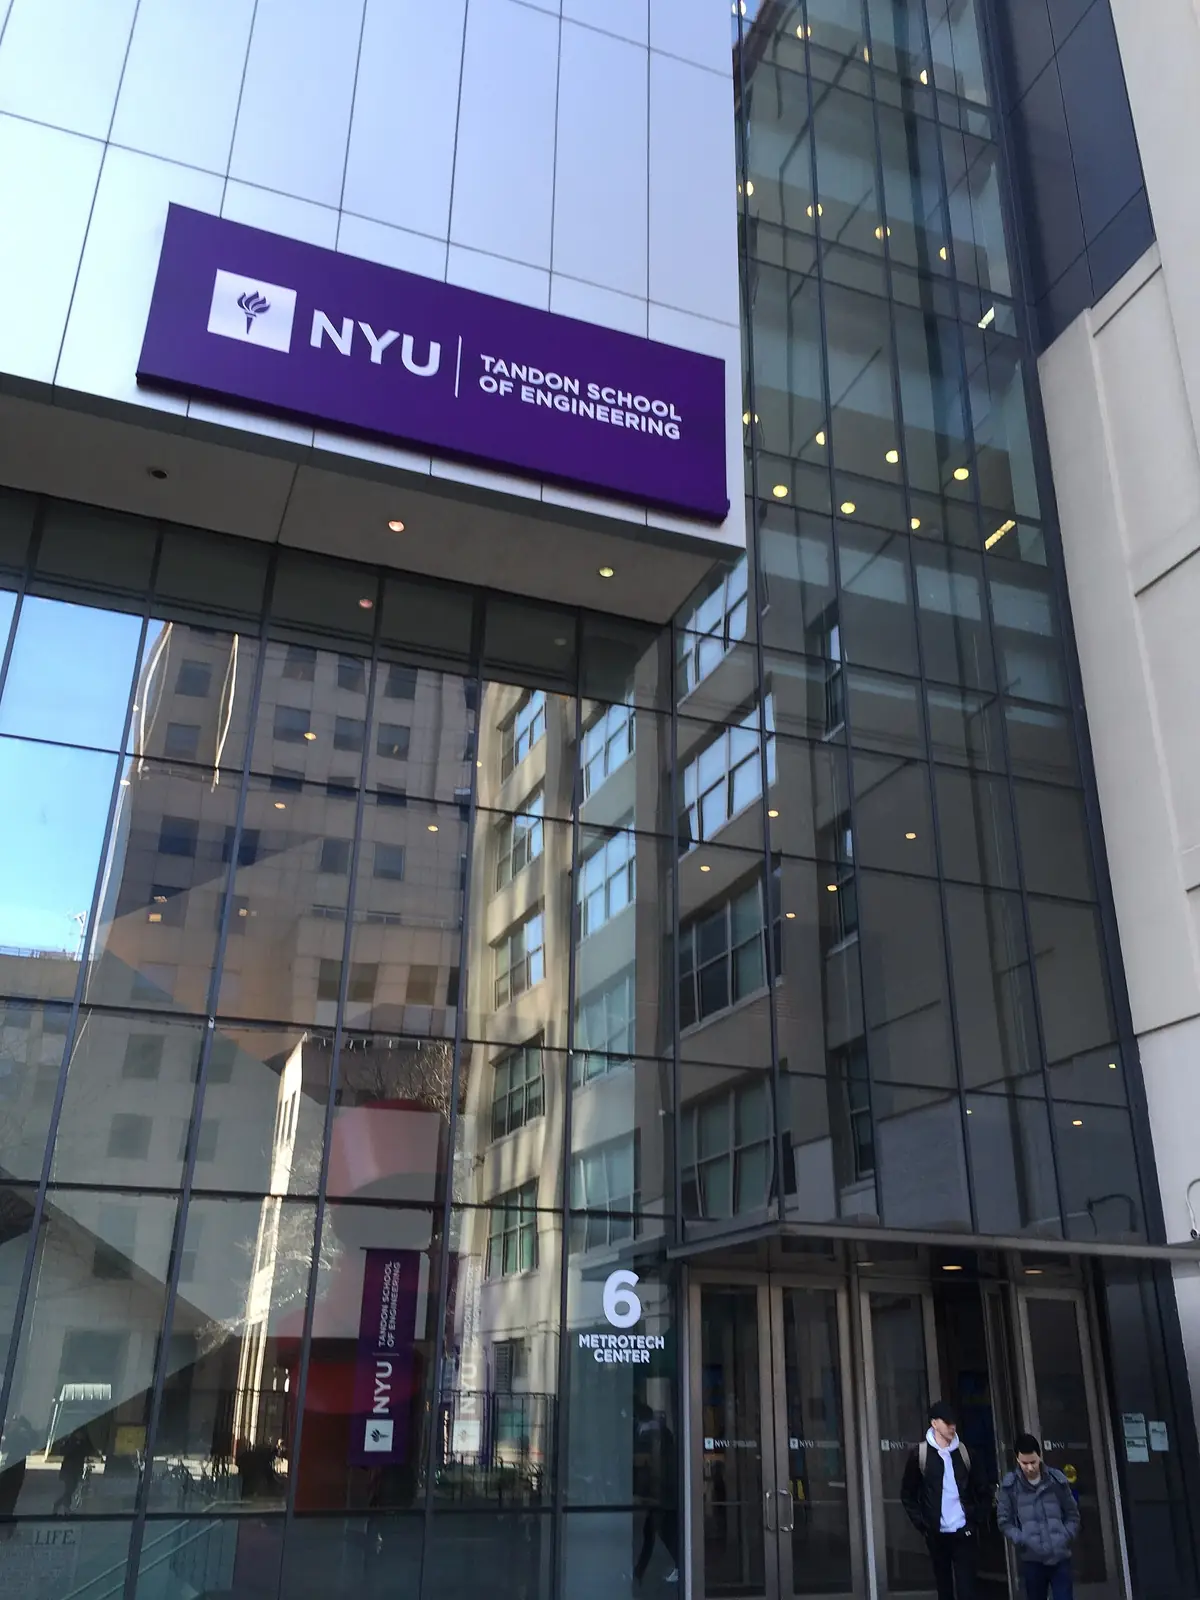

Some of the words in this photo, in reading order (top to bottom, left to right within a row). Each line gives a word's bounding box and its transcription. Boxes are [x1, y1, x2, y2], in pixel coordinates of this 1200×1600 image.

[310, 309, 442, 377] NYU
[479, 375, 512, 395] OF
[521, 383, 680, 440] ENGINEERING
[480, 354, 580, 396] TANDON
[587, 382, 682, 422] SCHOOL
[381, 1261, 392, 1302] SCHOOL
[388, 1262, 401, 1330] ENGINEERING
[602, 1269, 642, 1328] 6
[378, 1305, 388, 1347] TANDON
[386, 1334, 396, 1348] OF
[578, 1334, 665, 1349] METROTECH
[593, 1348, 650, 1364] CENTER
[372, 1361, 393, 1414] NYU
[459, 1362, 477, 1414] NYU
[714, 1440, 729, 1448] NYU
